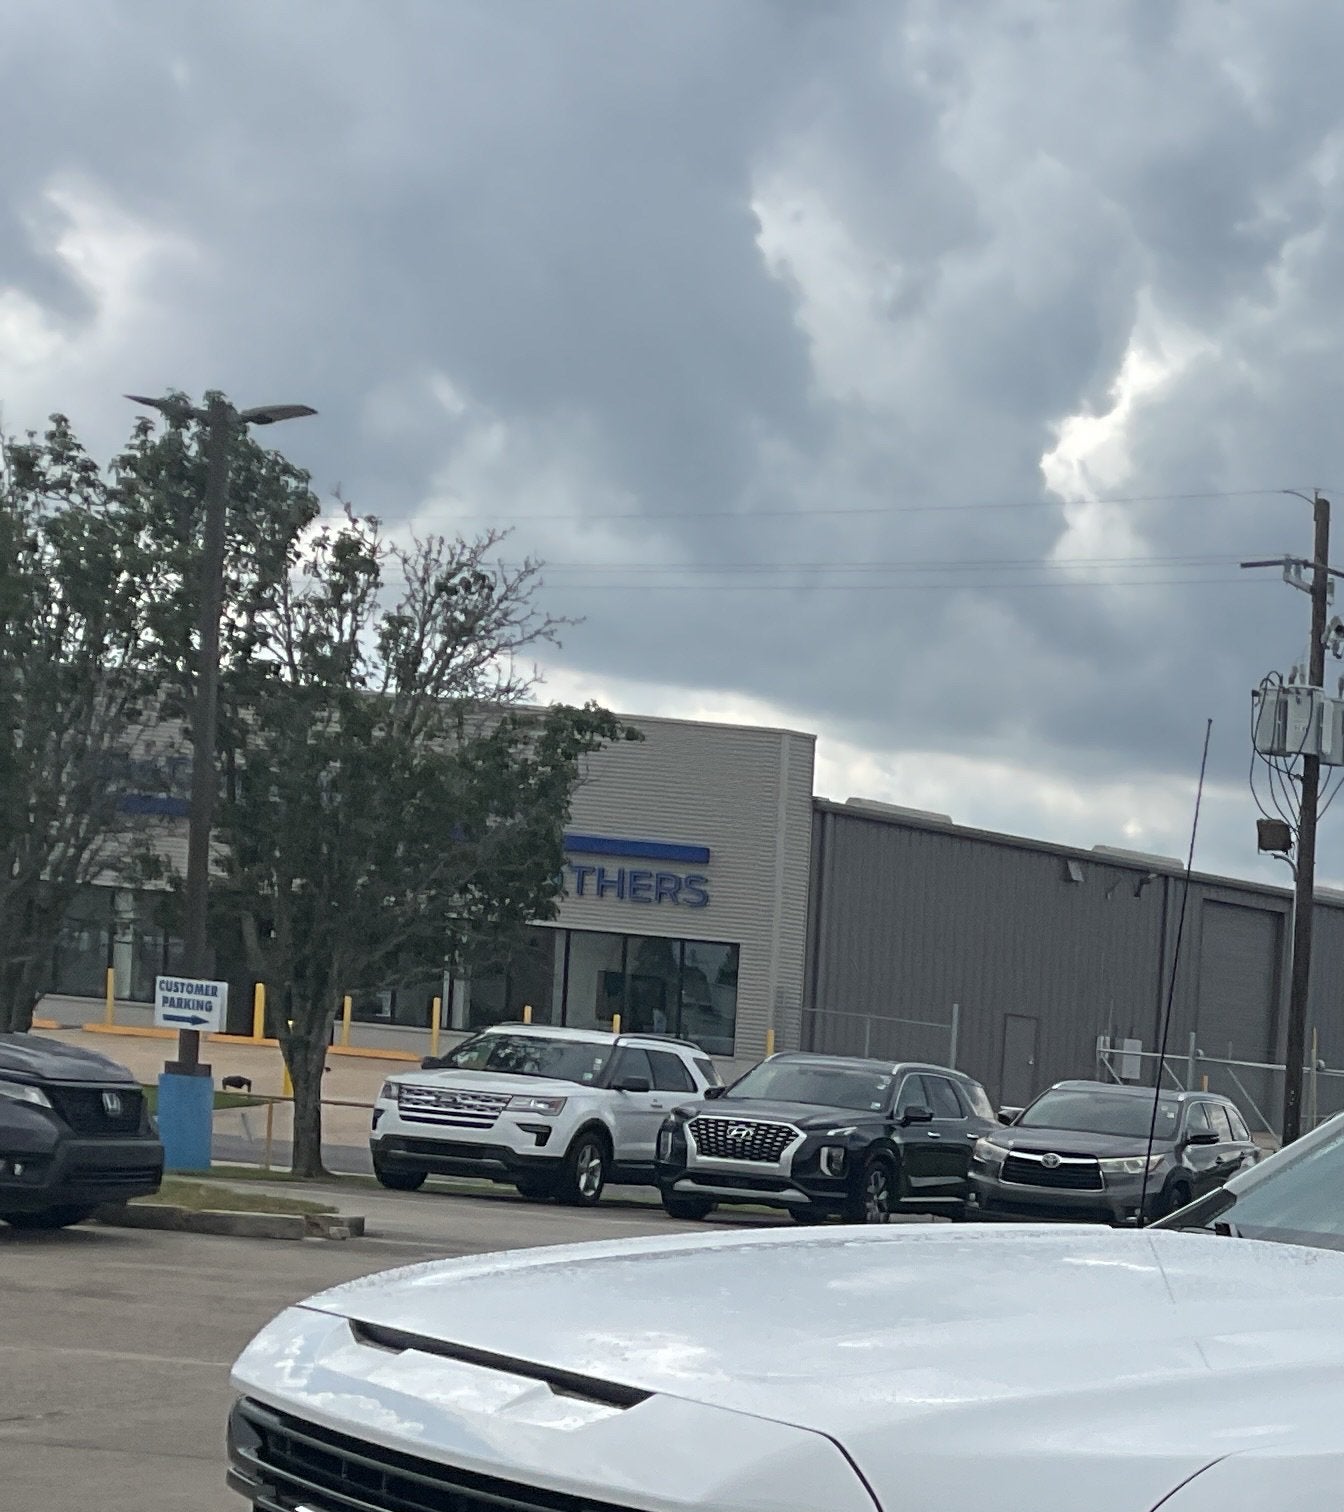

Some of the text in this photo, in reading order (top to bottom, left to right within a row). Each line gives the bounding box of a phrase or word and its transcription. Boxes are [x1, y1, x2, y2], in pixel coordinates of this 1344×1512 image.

[560, 863, 710, 908] THERS
[159, 980, 218, 998] CUSTOMER
[162, 996, 213, 1012] PARKING
